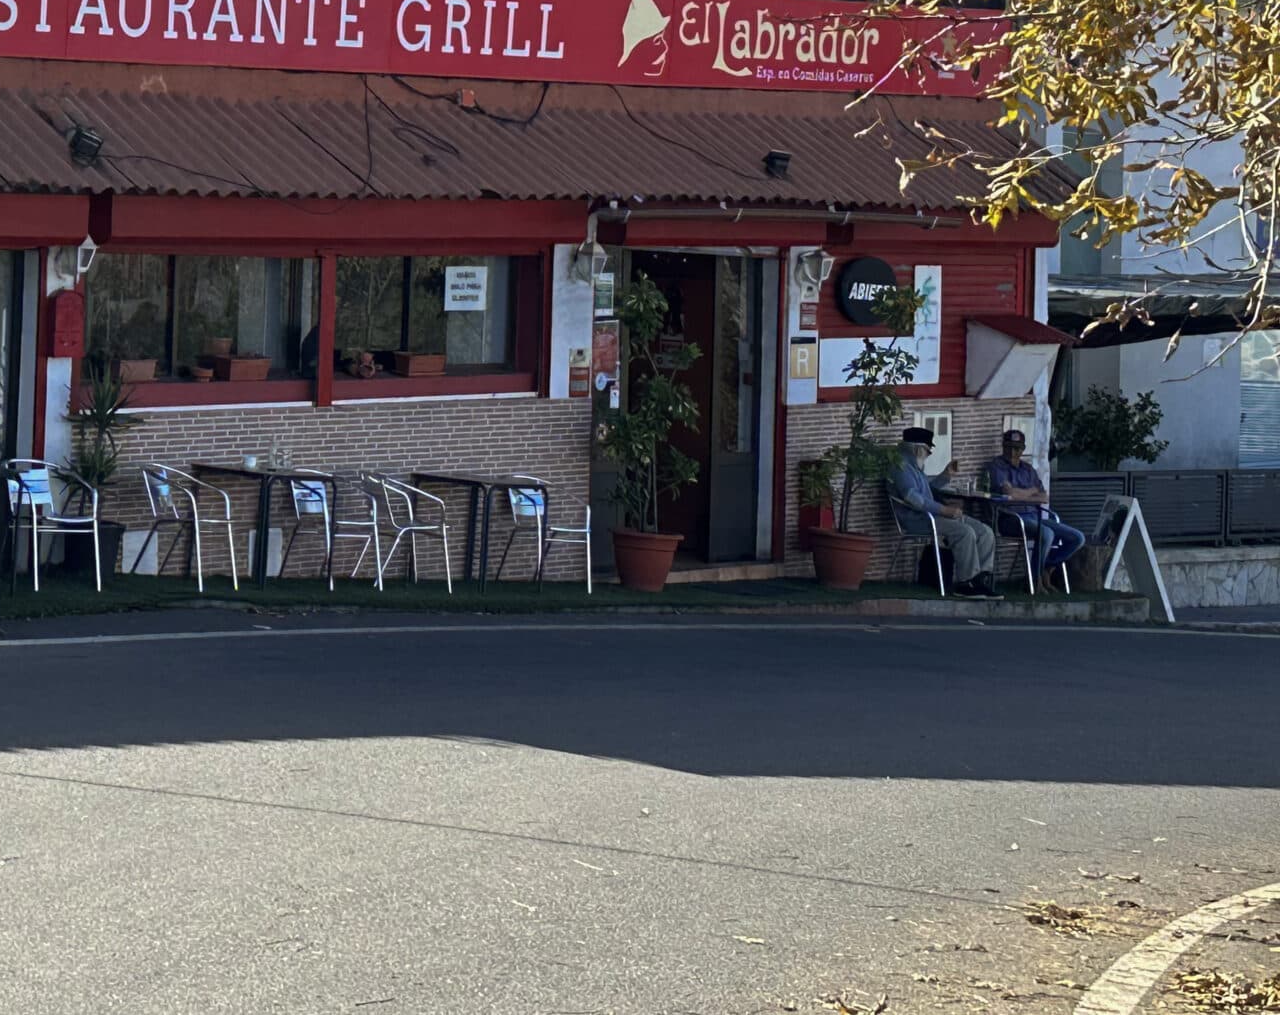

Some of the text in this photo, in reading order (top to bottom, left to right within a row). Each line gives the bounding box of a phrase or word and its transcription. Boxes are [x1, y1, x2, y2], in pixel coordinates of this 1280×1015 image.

[679, 1, 713, 46] El
[712, 0, 880, 76] Labrador
[848, 282, 897, 301] ABIE
[796, 347, 809, 376] R
